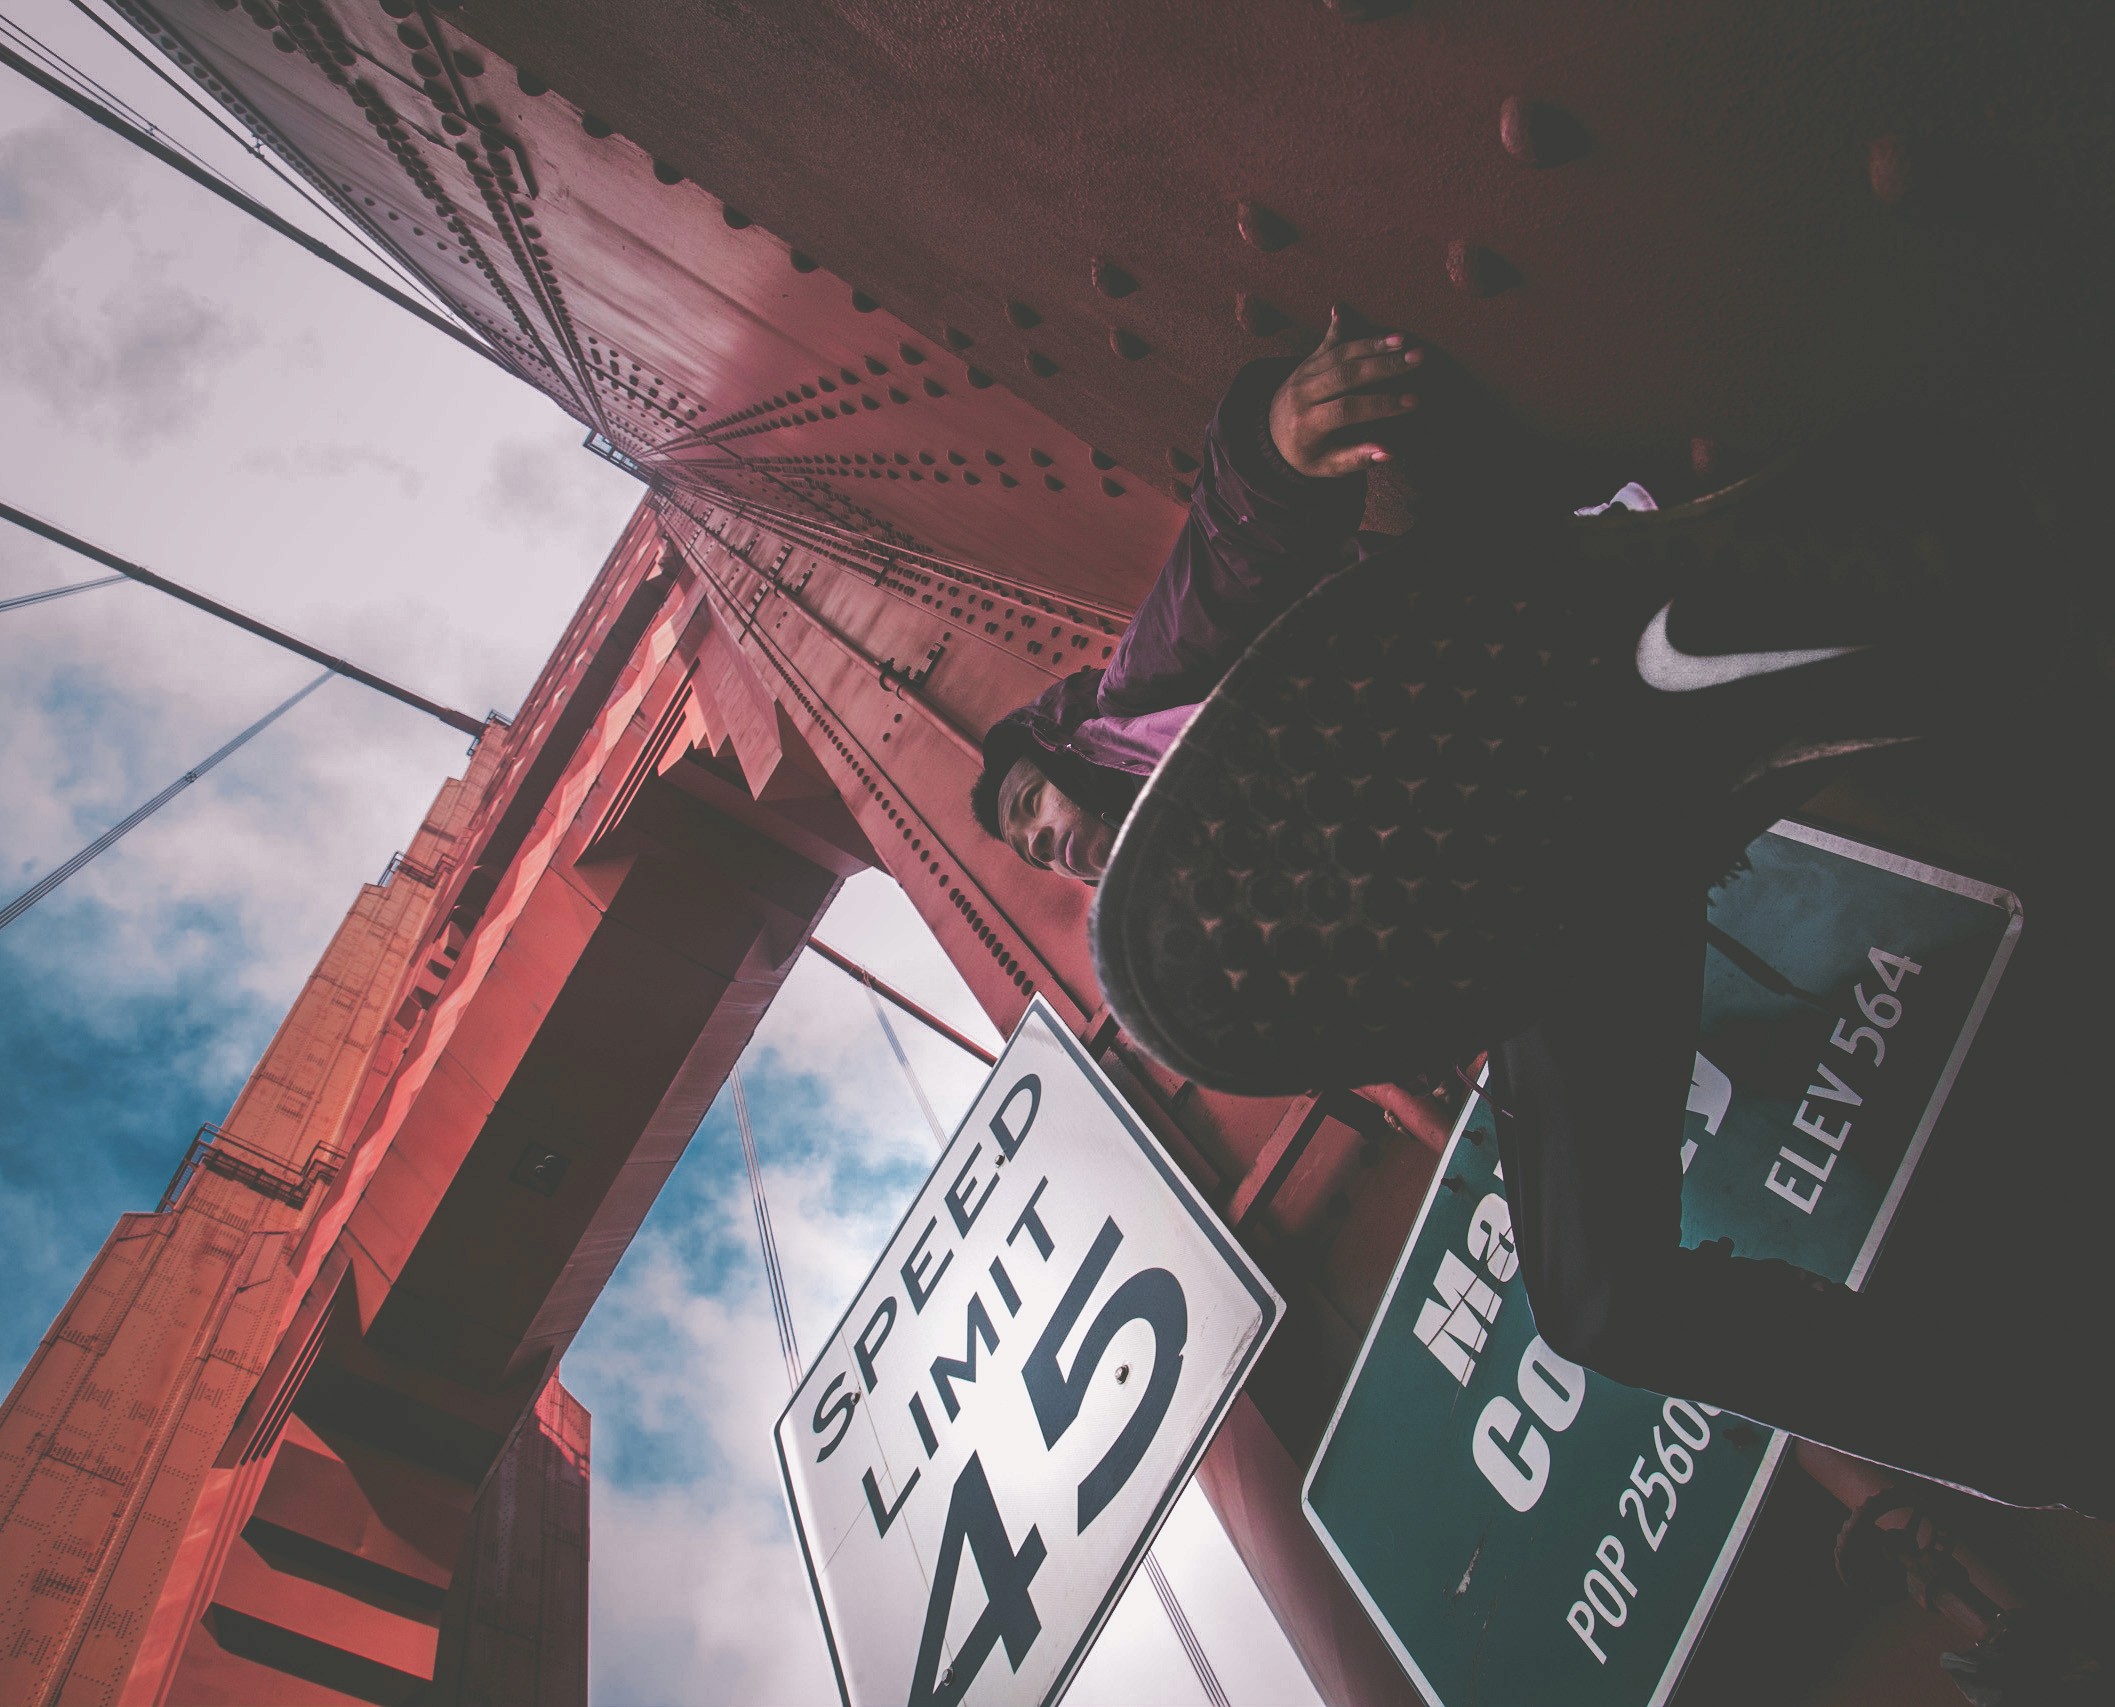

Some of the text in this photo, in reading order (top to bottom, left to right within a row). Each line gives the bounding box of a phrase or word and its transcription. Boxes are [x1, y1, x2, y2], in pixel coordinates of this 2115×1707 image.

[1764, 946, 1923, 1215] ELEV 564
[811, 1073, 1042, 1463] SPEED
[862, 1176, 1055, 1539] LIMIT
[1413, 1161, 1519, 1387] Ma
[908, 1215, 1188, 1707] 45
[1566, 1397, 1731, 1664] POP 2560
